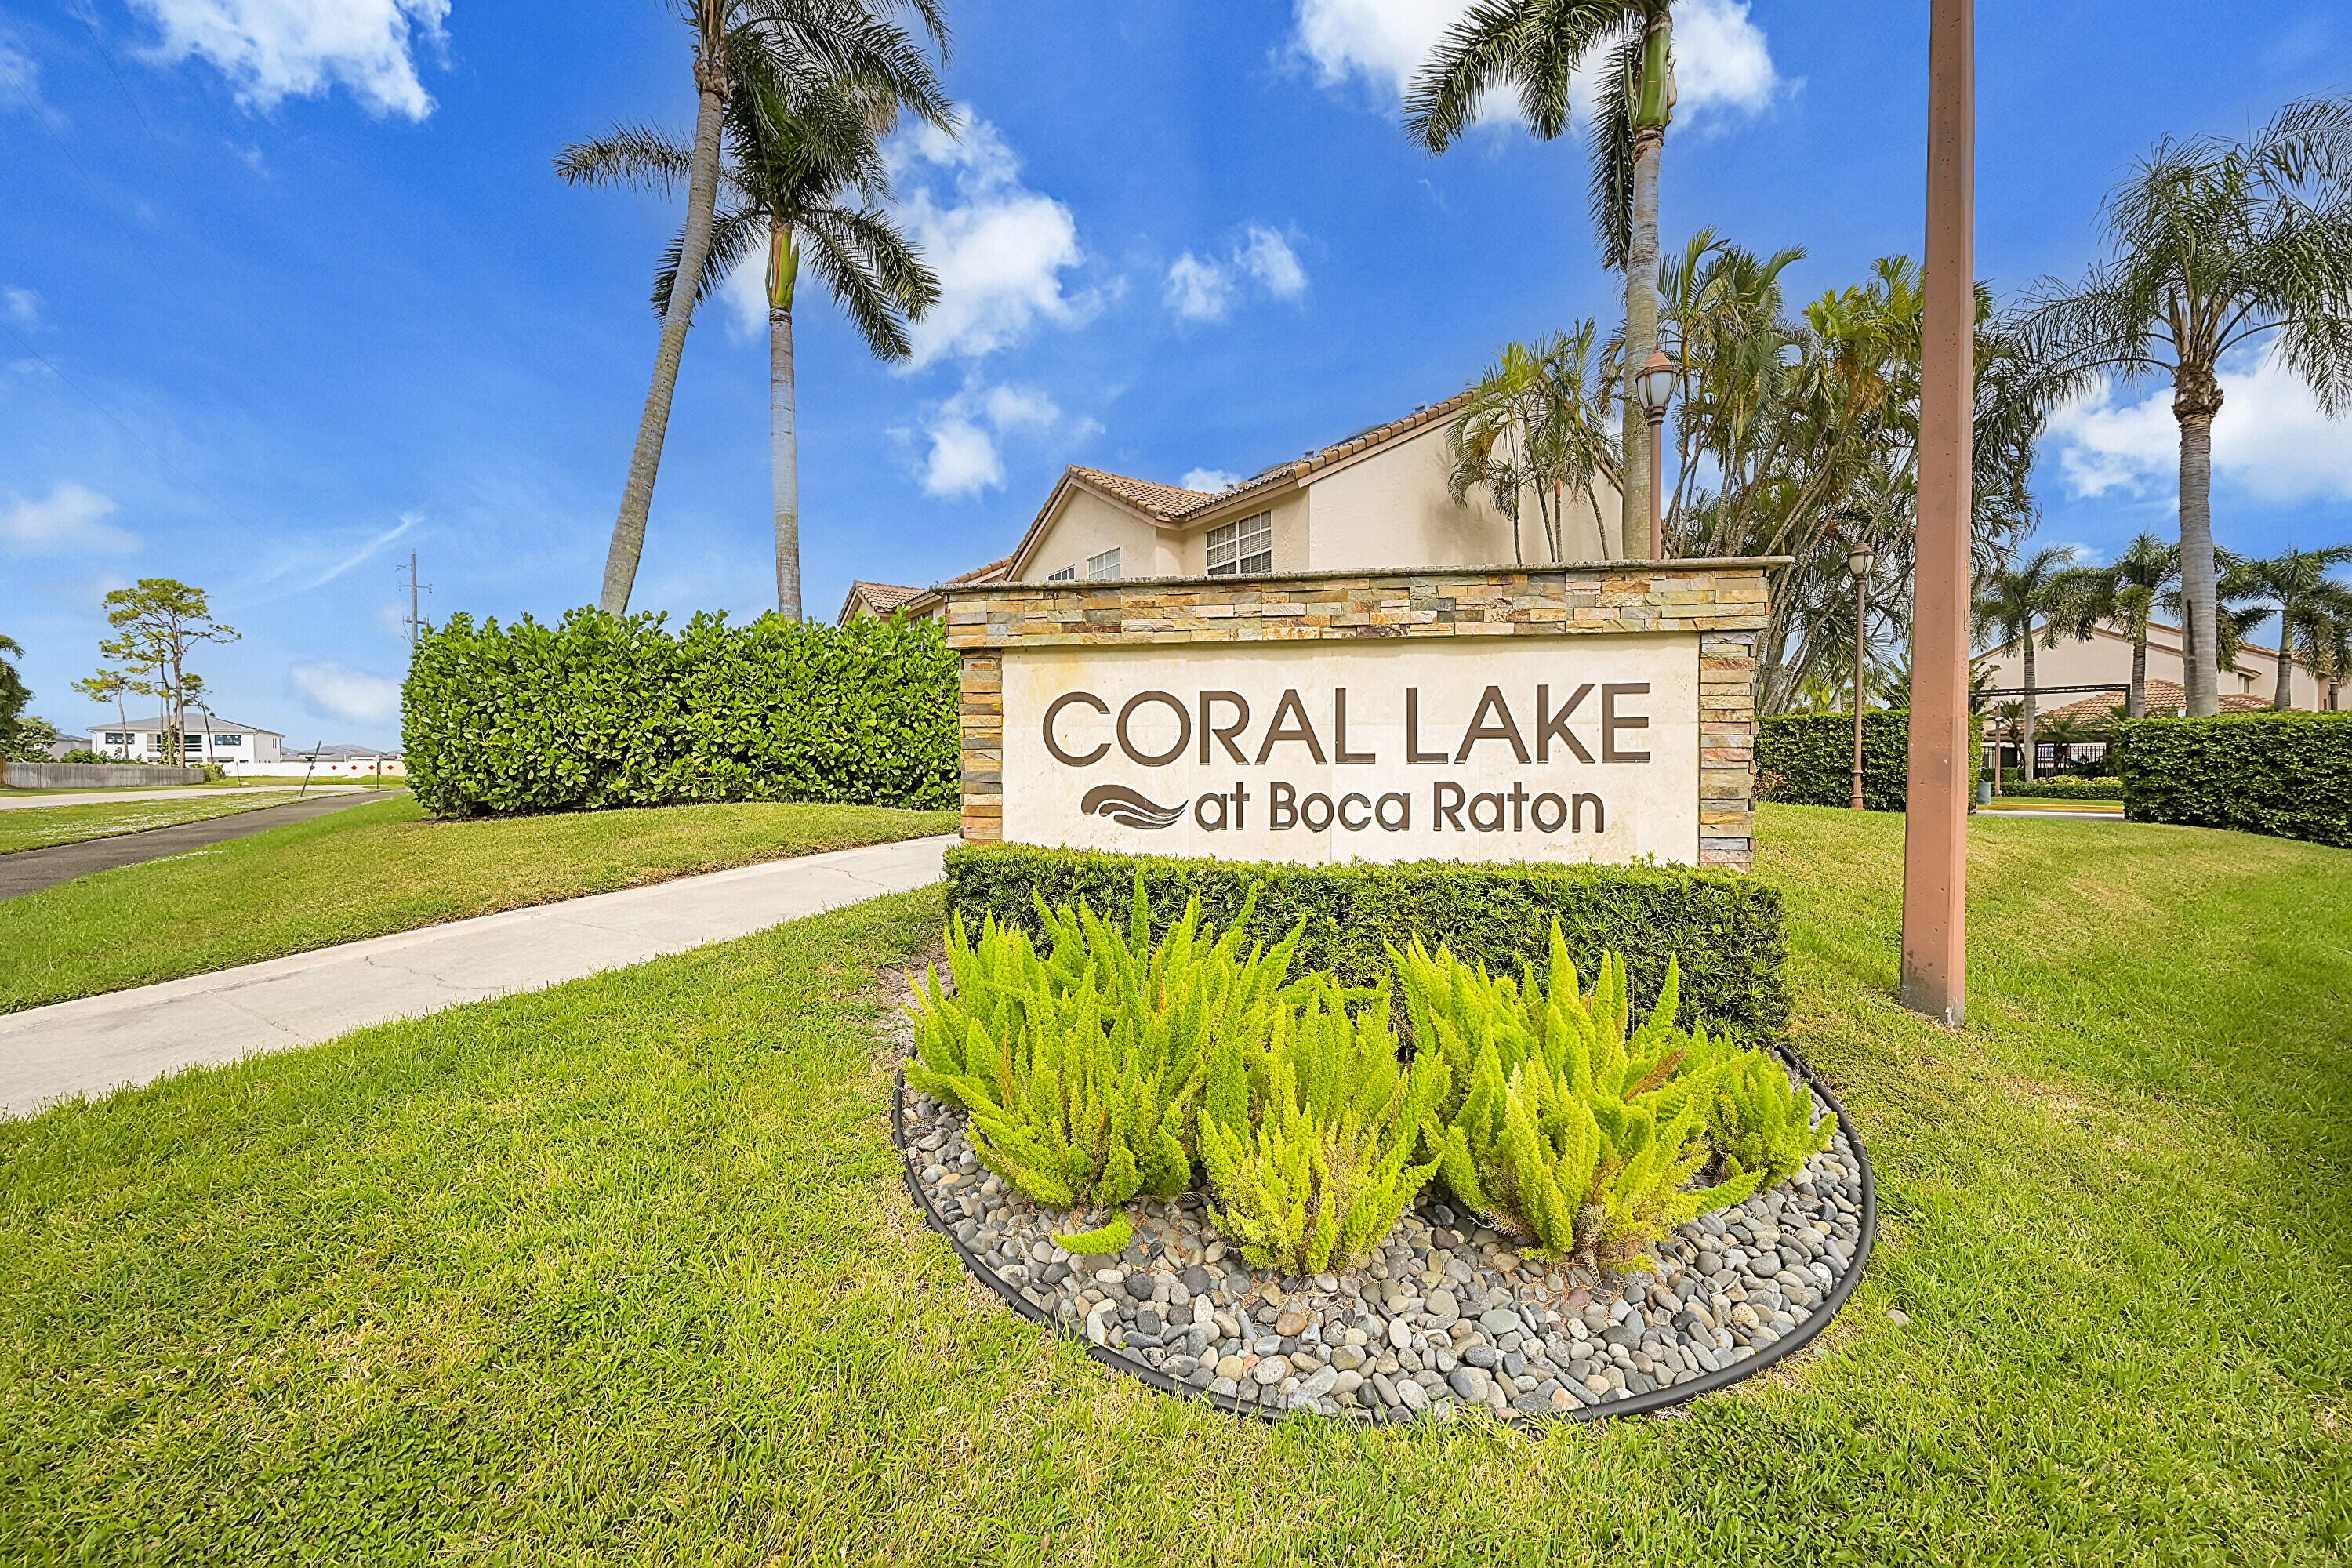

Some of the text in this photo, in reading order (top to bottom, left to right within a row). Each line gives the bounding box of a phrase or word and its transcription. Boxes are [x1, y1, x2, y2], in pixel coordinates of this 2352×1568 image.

[1042, 682, 1651, 768] CORAL LAKE
[1194, 781, 1605, 833] at Boca Raton
